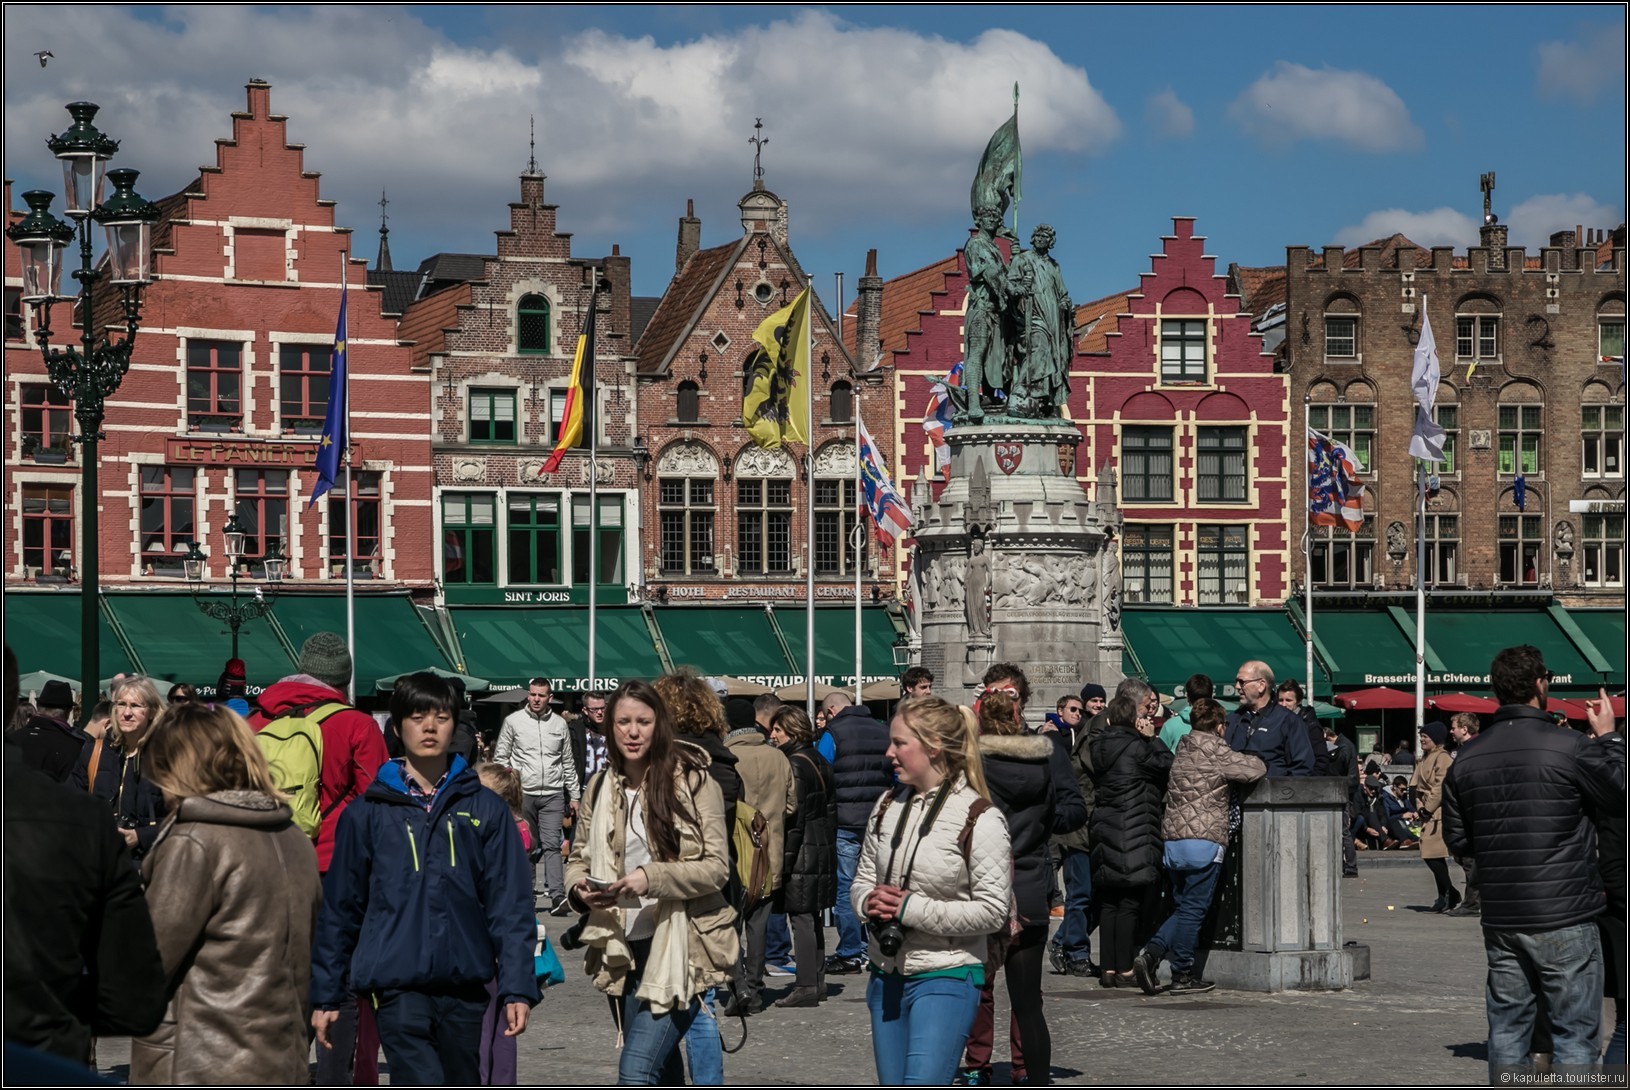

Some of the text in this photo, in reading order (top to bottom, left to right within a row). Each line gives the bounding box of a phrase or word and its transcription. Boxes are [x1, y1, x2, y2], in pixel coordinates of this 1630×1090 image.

[175, 445, 203, 461] LE
[210, 442, 297, 464] PANIER
[504, 591, 570, 602] SINT JORIS
[672, 586, 864, 598] HOTEL RESTAURANT CENTRA
[1365, 674, 1417, 683] Brasserie
[1427, 674, 1441, 683] La
[1443, 674, 1481, 683] Civiere
[529, 678, 620, 692] NT-JORIS
